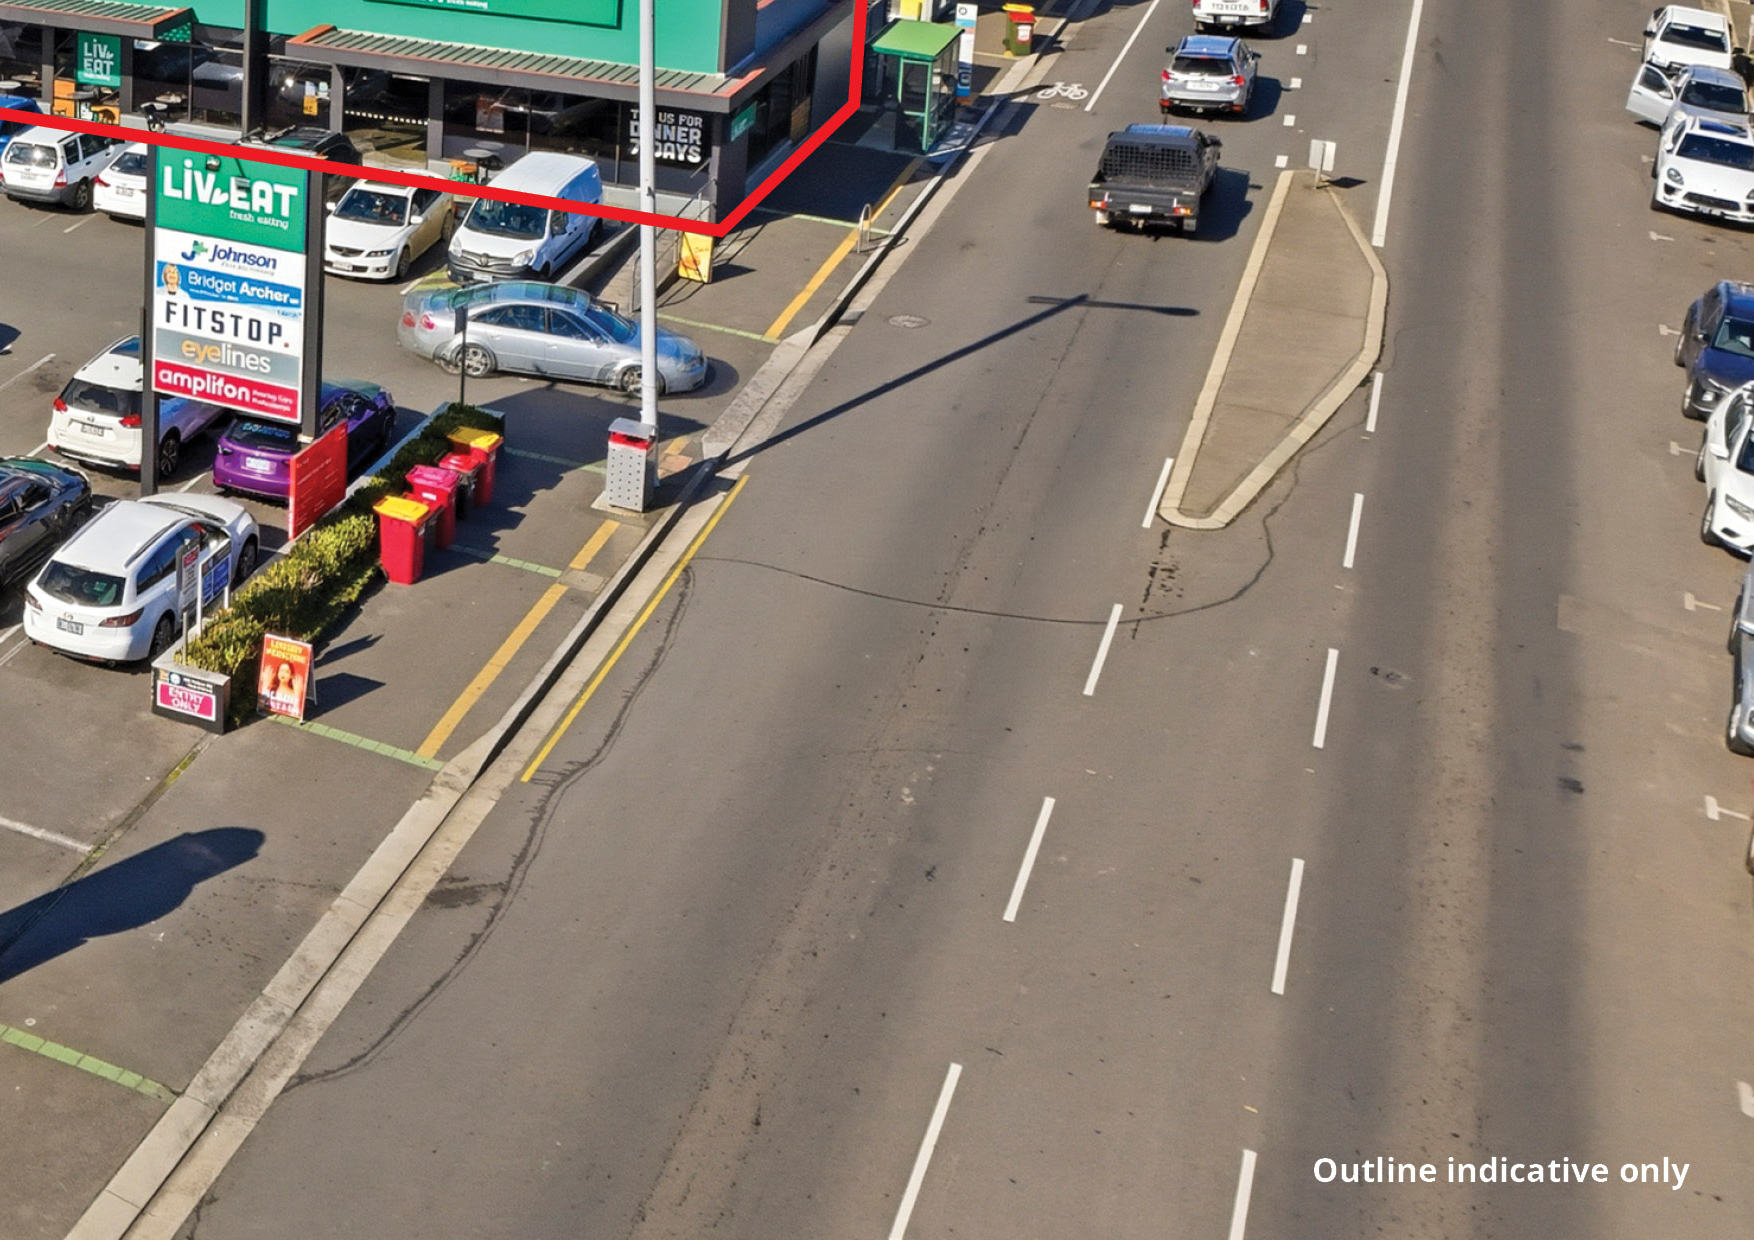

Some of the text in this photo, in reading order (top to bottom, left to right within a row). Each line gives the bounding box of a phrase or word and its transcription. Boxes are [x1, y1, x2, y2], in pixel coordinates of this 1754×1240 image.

[630, 120, 702, 145] DNNER
[658, 112, 703, 128] US FOR
[208, 244, 277, 269] Johnson
[239, 282, 290, 303] Archer
[181, 338, 271, 374] eyelines
[159, 369, 250, 402] amplifon
